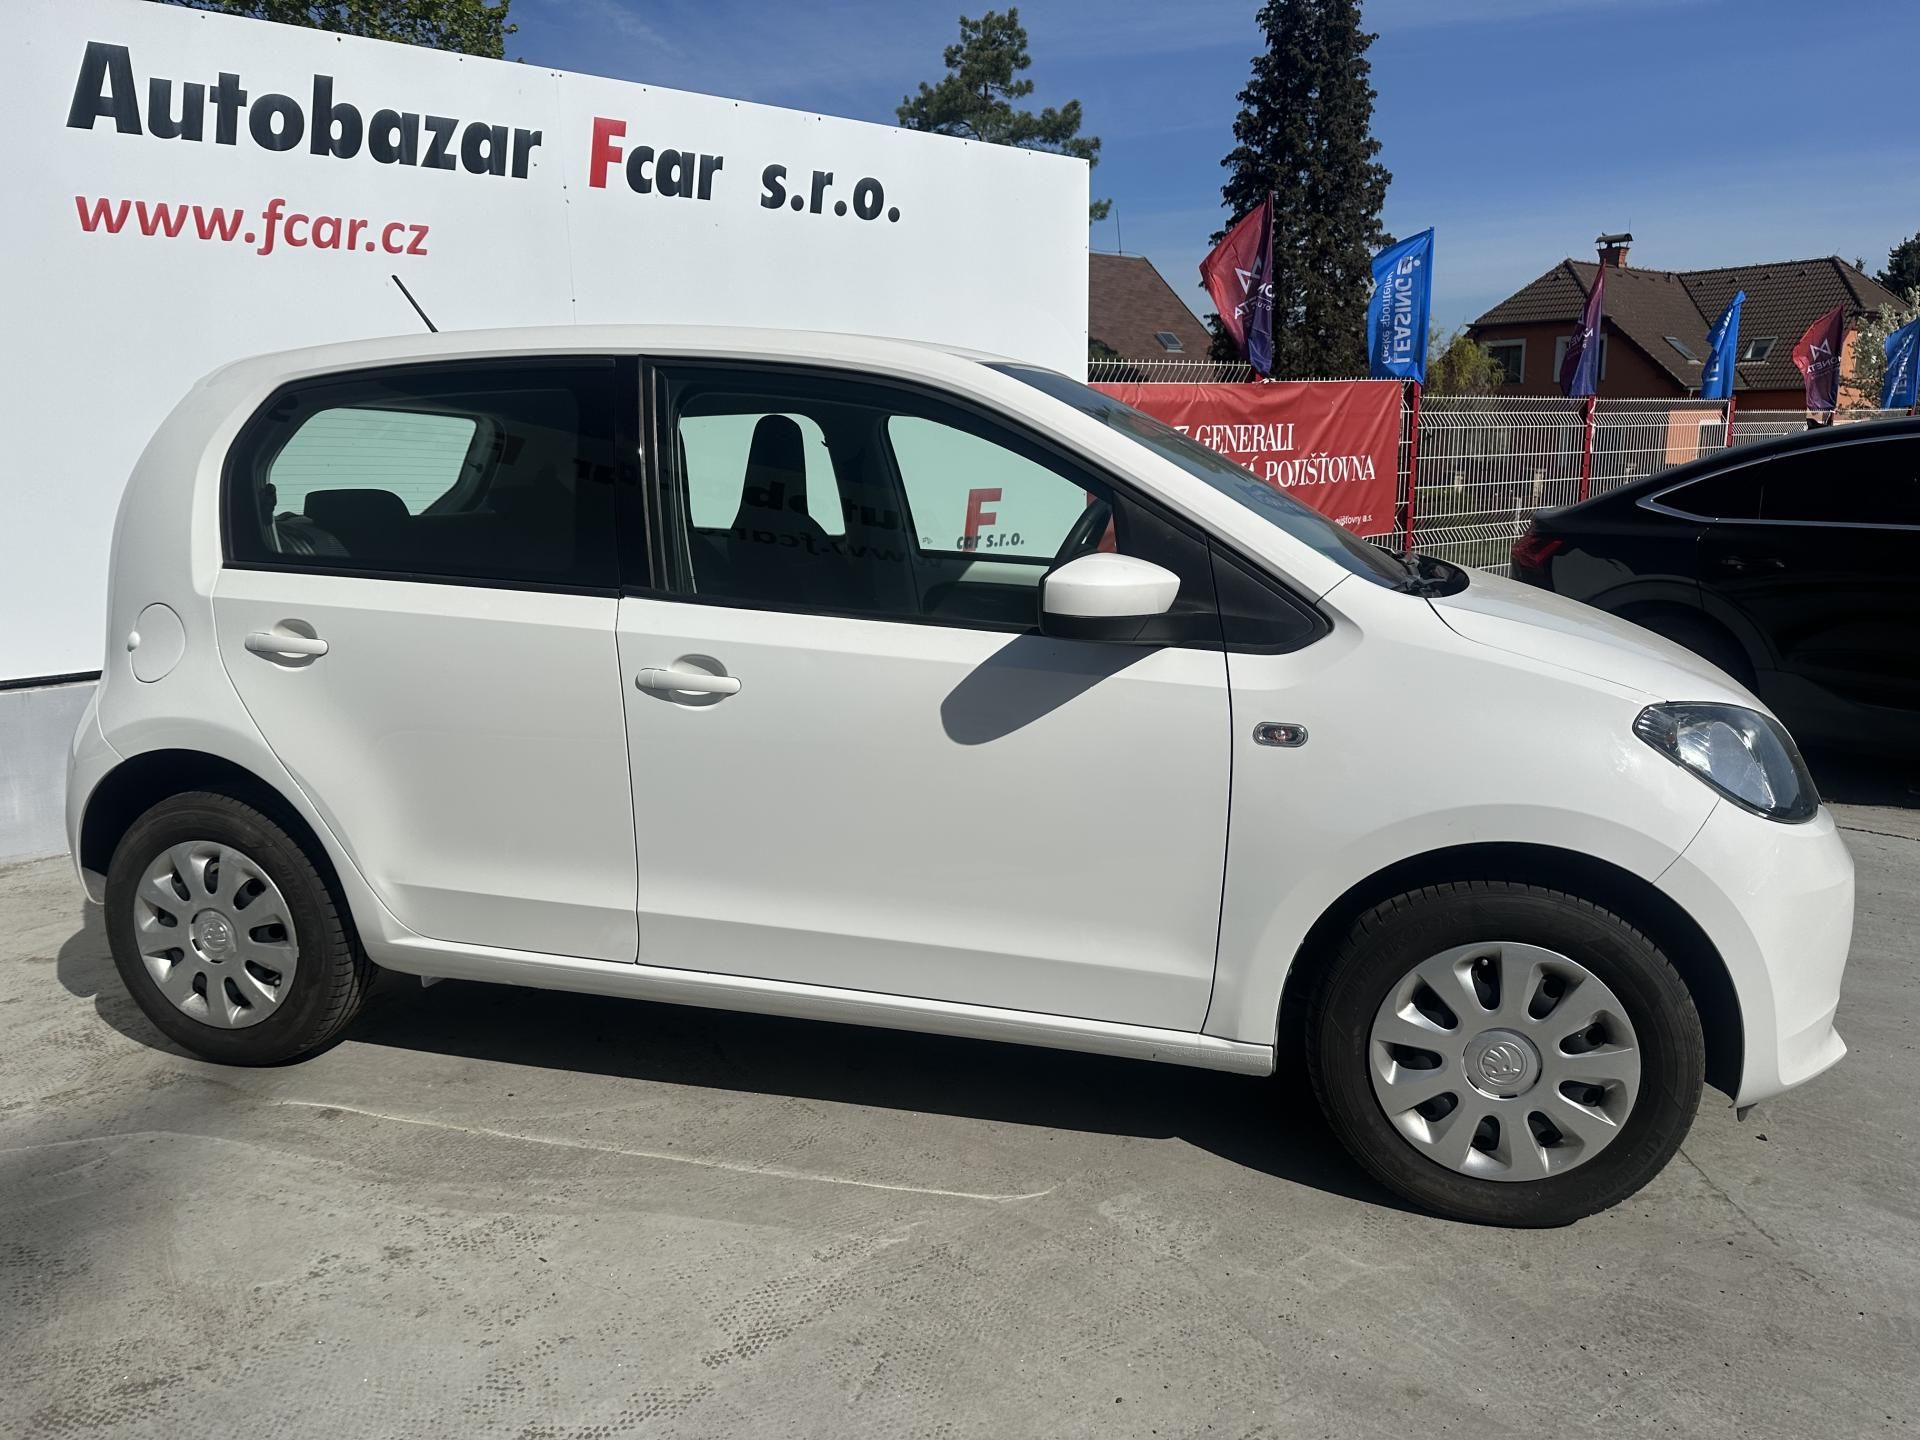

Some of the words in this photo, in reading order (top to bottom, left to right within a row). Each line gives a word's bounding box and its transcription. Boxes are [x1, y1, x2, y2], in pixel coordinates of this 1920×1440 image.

[66, 41, 542, 179] Autobazar
[588, 116, 724, 200] Fcar
[760, 163, 901, 223] s.r.o.
[74, 195, 430, 256] www.fcar.cz
[1195, 423, 1294, 454] GENERALI
[1265, 451, 1376, 488] POJIŠŤOVNA
